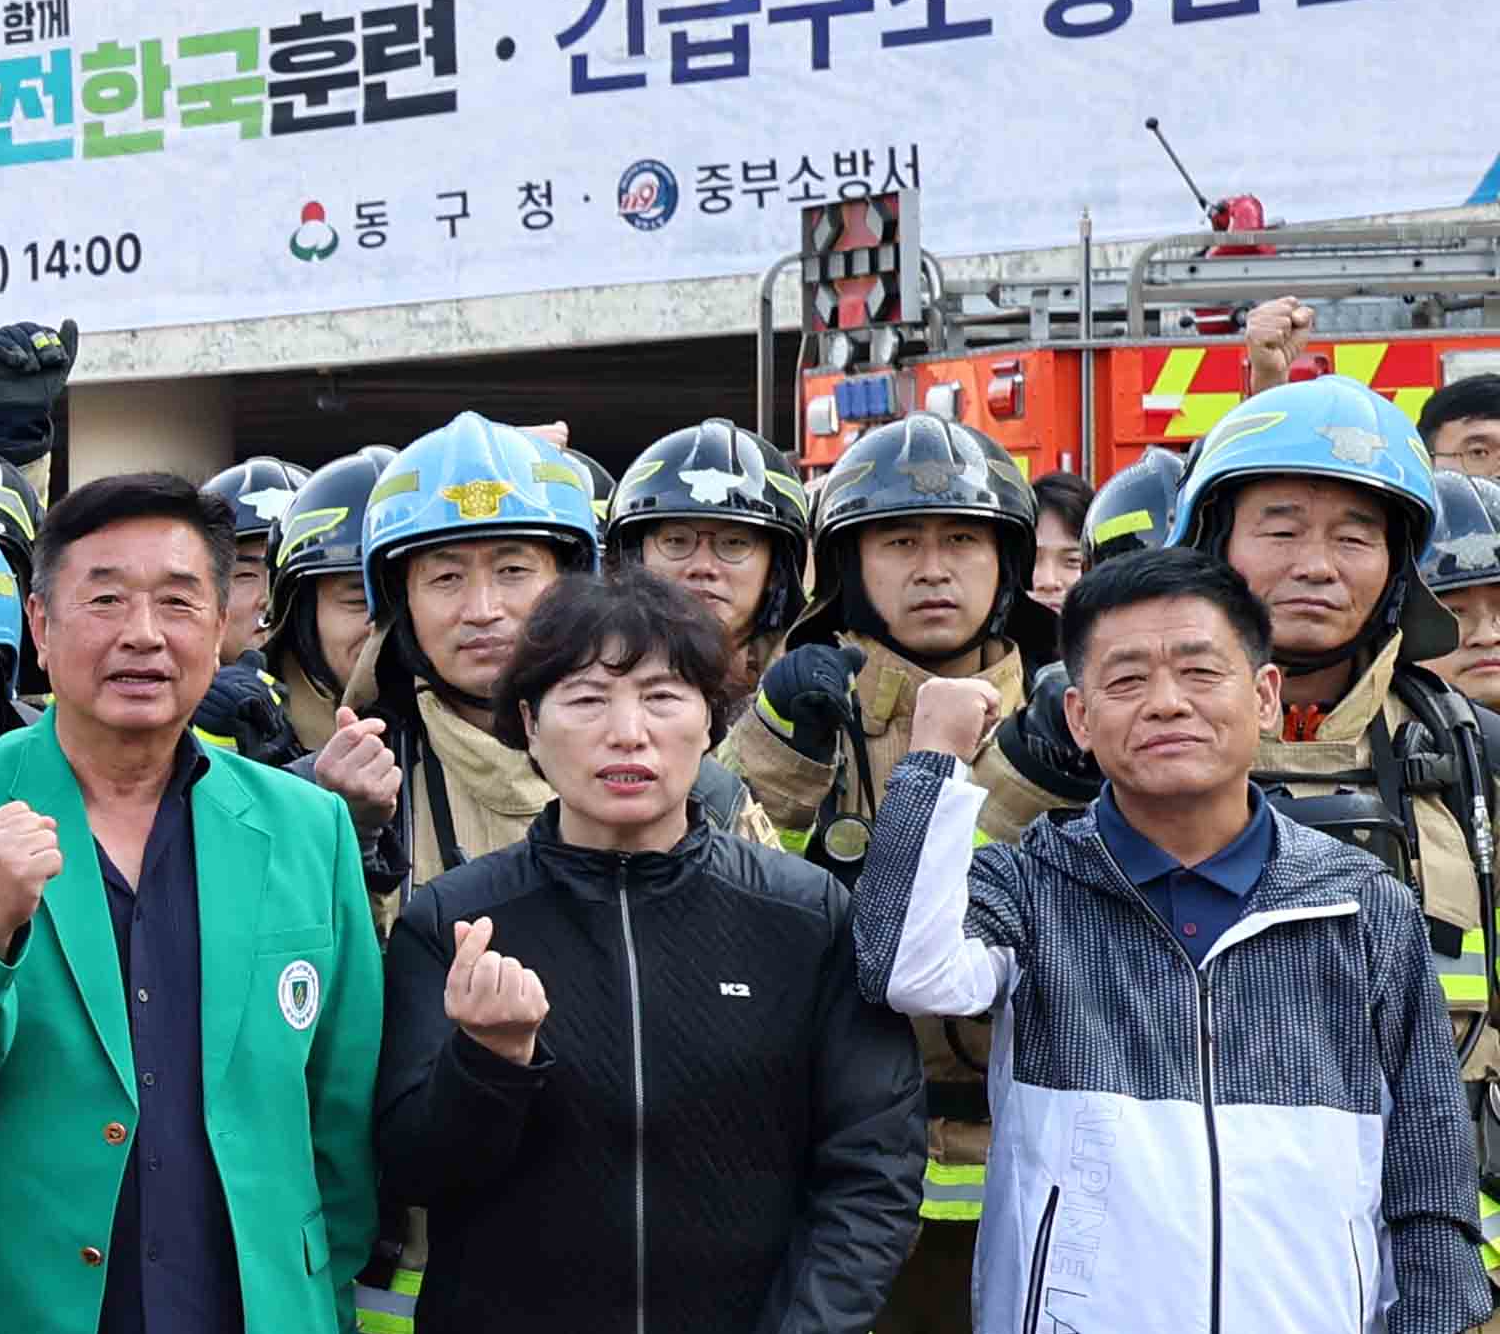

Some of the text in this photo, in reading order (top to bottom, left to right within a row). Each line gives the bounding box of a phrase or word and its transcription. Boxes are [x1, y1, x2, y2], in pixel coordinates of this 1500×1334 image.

[695, 144, 920, 215] 중부소방서
[23, 232, 143, 281] 14:00
[719, 982, 751, 997] K2
